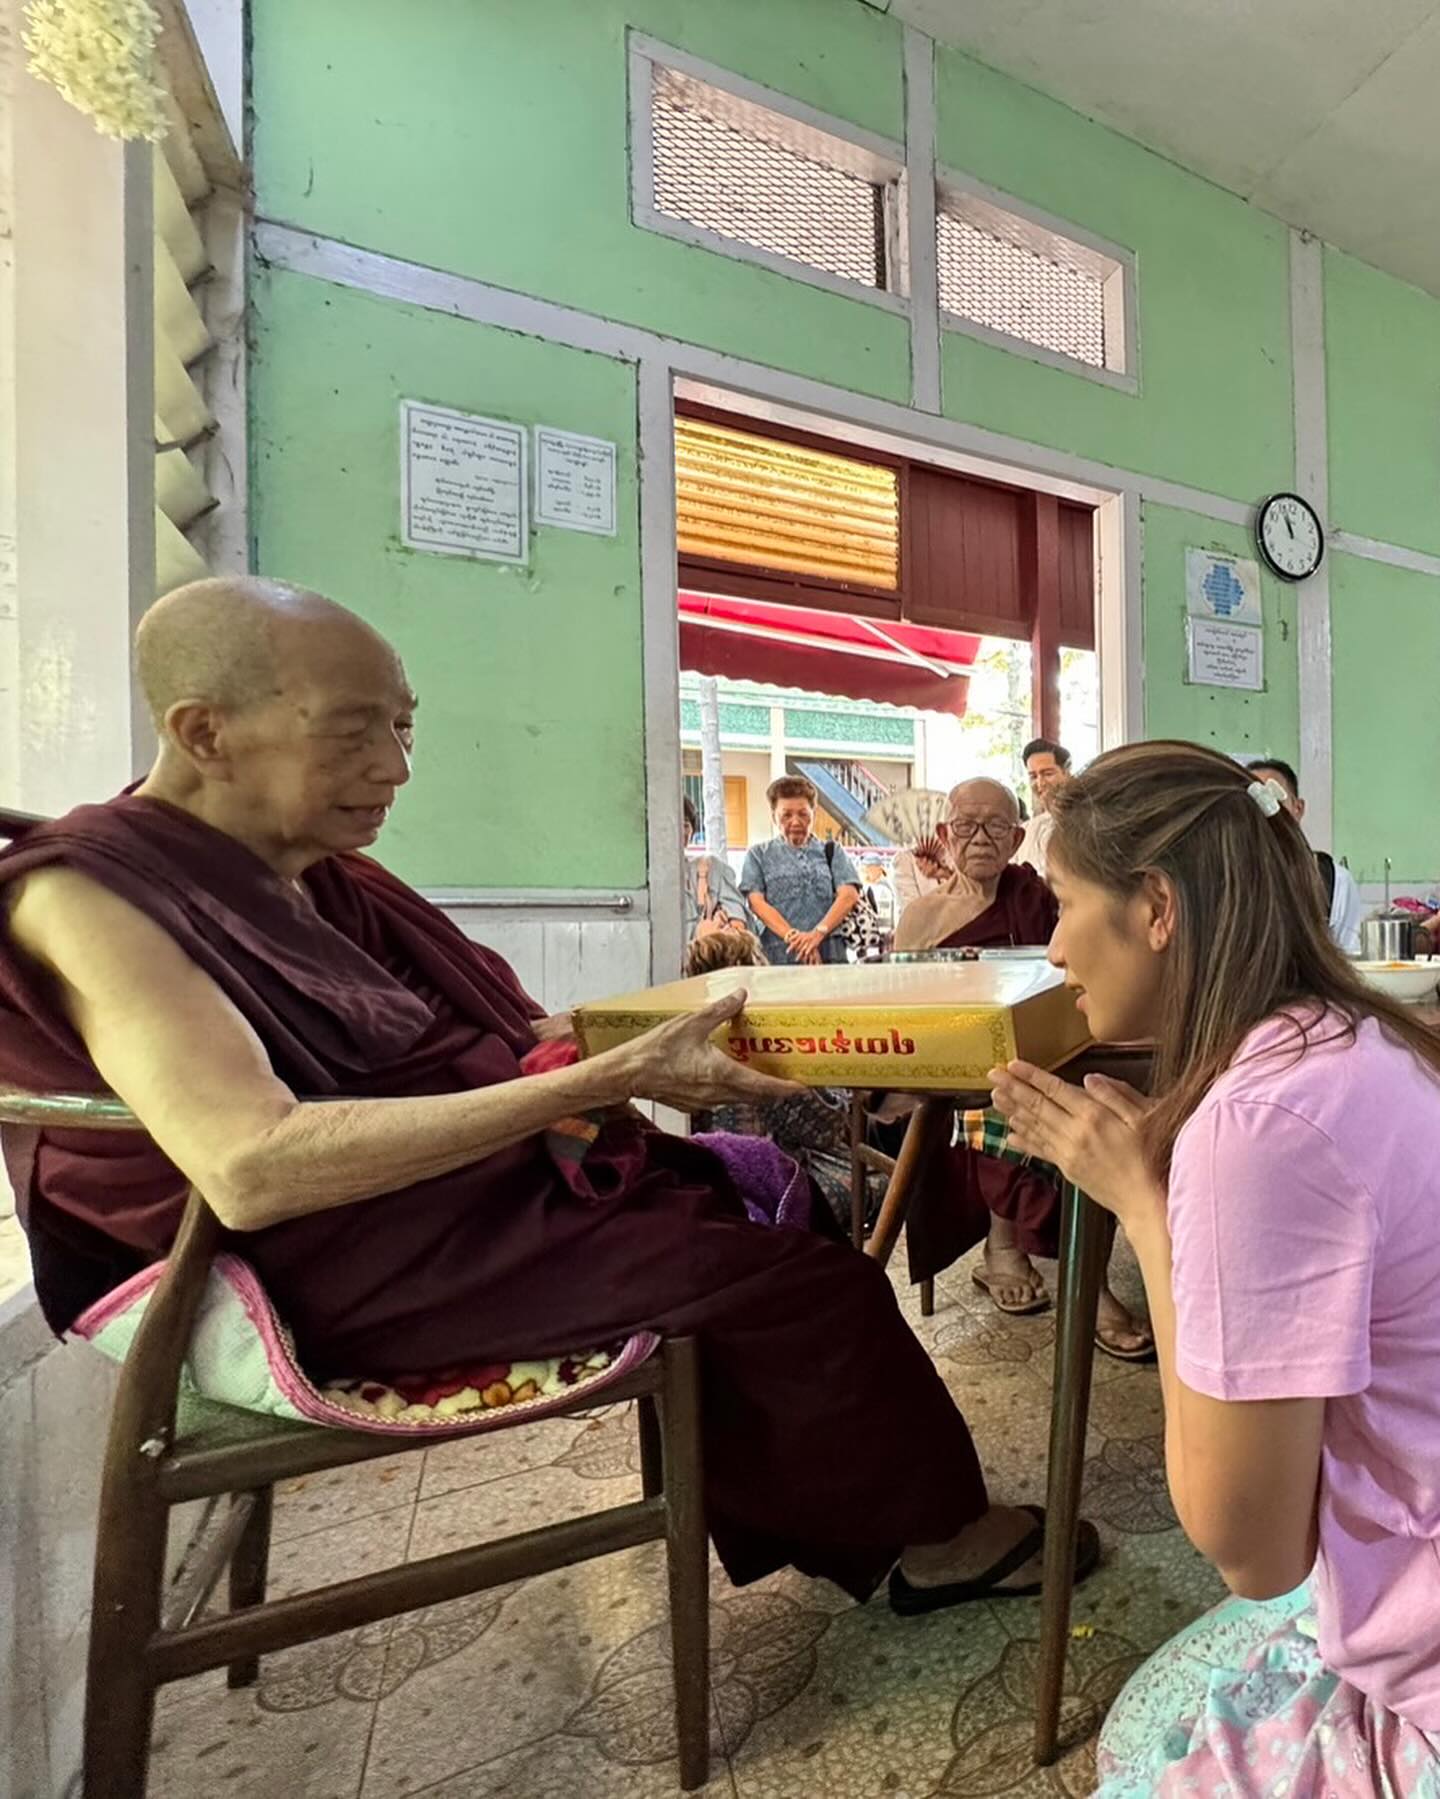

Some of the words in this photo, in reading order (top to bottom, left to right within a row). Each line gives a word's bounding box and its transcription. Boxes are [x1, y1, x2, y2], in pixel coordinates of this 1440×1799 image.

[1289, 503, 1297, 515] 12
[1302, 511, 1306, 522] 1
[1308, 522, 1314, 534] 2
[1287, 560, 1294, 570] 6
[1299, 559, 1305, 570] 5
